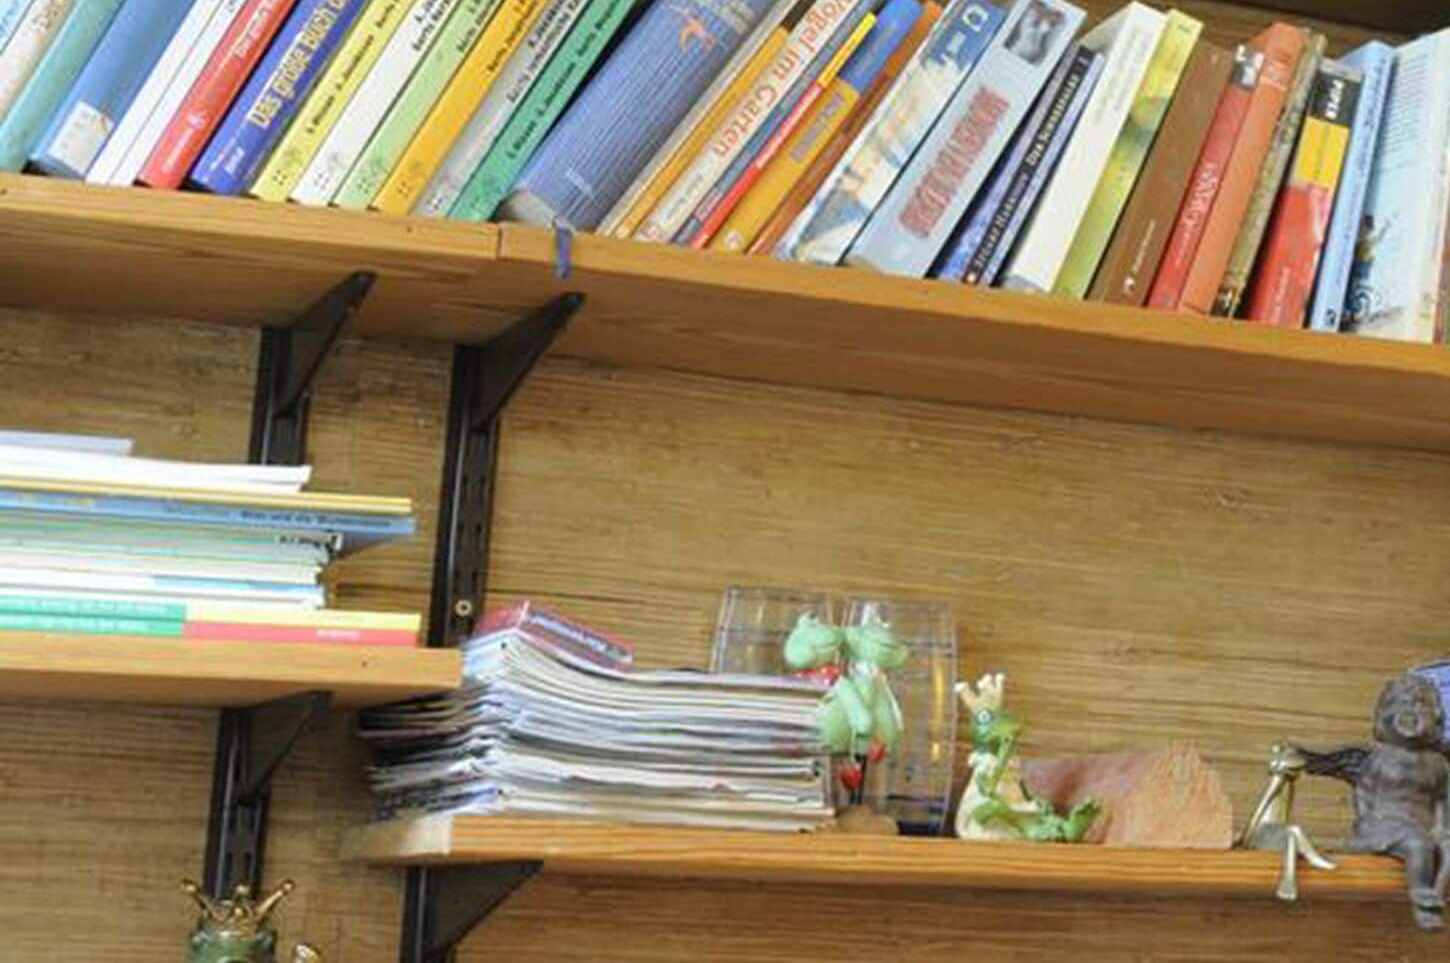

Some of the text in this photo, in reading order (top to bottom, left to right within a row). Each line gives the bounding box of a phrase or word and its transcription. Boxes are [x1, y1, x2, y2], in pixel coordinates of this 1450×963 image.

[247, 87, 281, 129] Das
[268, 45, 311, 100] große
[297, 4, 336, 53] Buch
[772, 48, 805, 84] im
[709, 80, 782, 163] Garten
